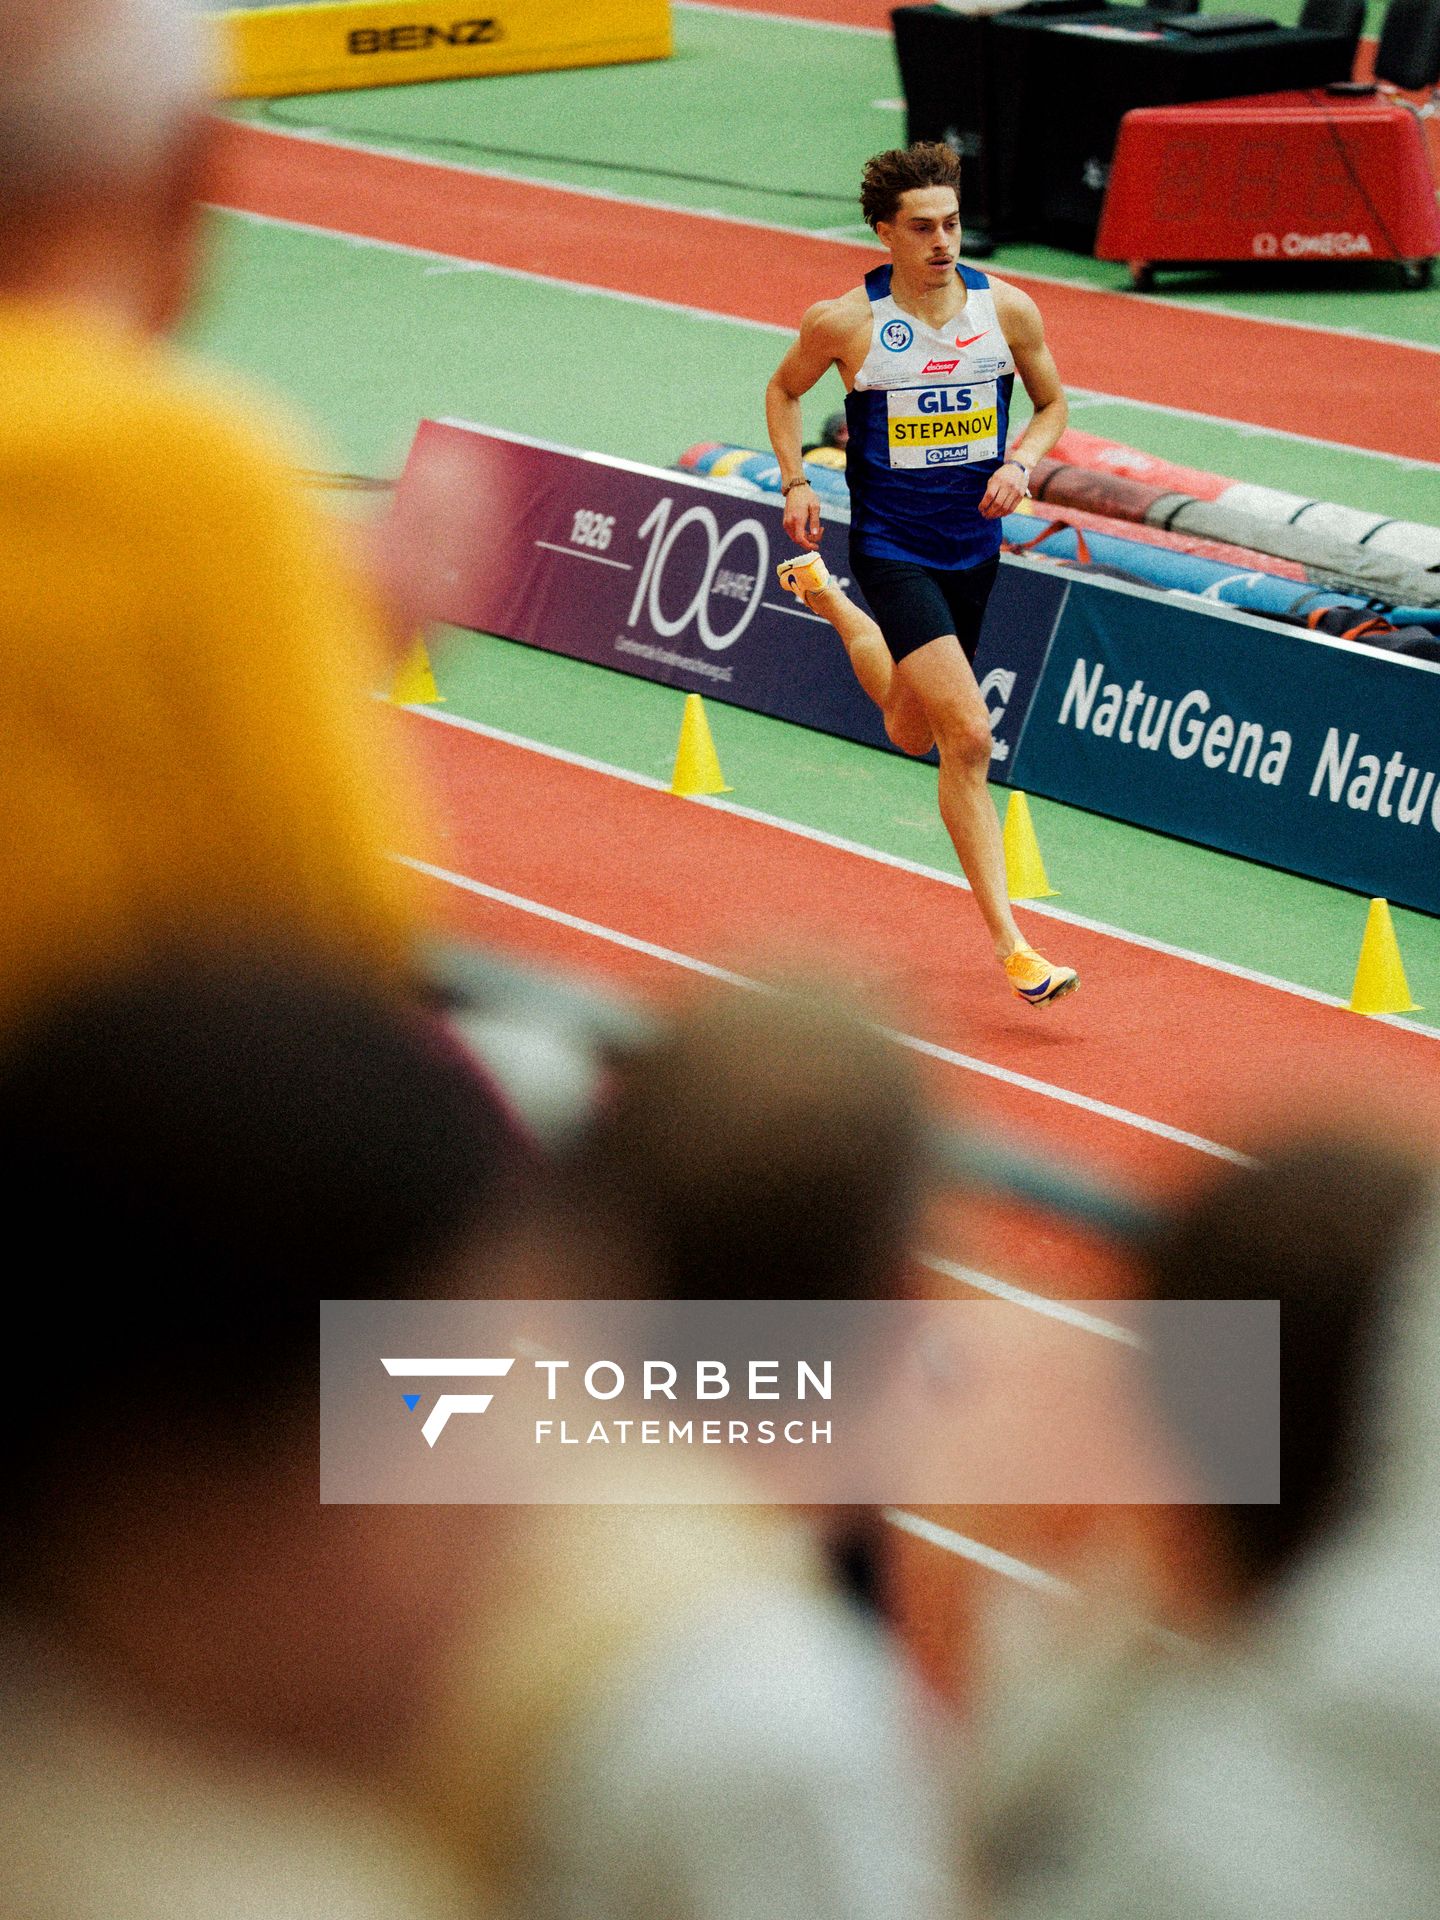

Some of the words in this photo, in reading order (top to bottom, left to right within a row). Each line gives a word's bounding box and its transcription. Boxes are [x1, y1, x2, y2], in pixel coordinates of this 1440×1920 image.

[347, 18, 497, 54] BENZ
[1281, 232, 1373, 256] OMEGA
[895, 414, 993, 440] STEPANOV
[943, 448, 967, 458] PLAN
[571, 509, 616, 550] 1926
[628, 497, 769, 650] 100
[1057, 657, 1293, 786] NatuGena
[1309, 727, 1440, 834] Natu
